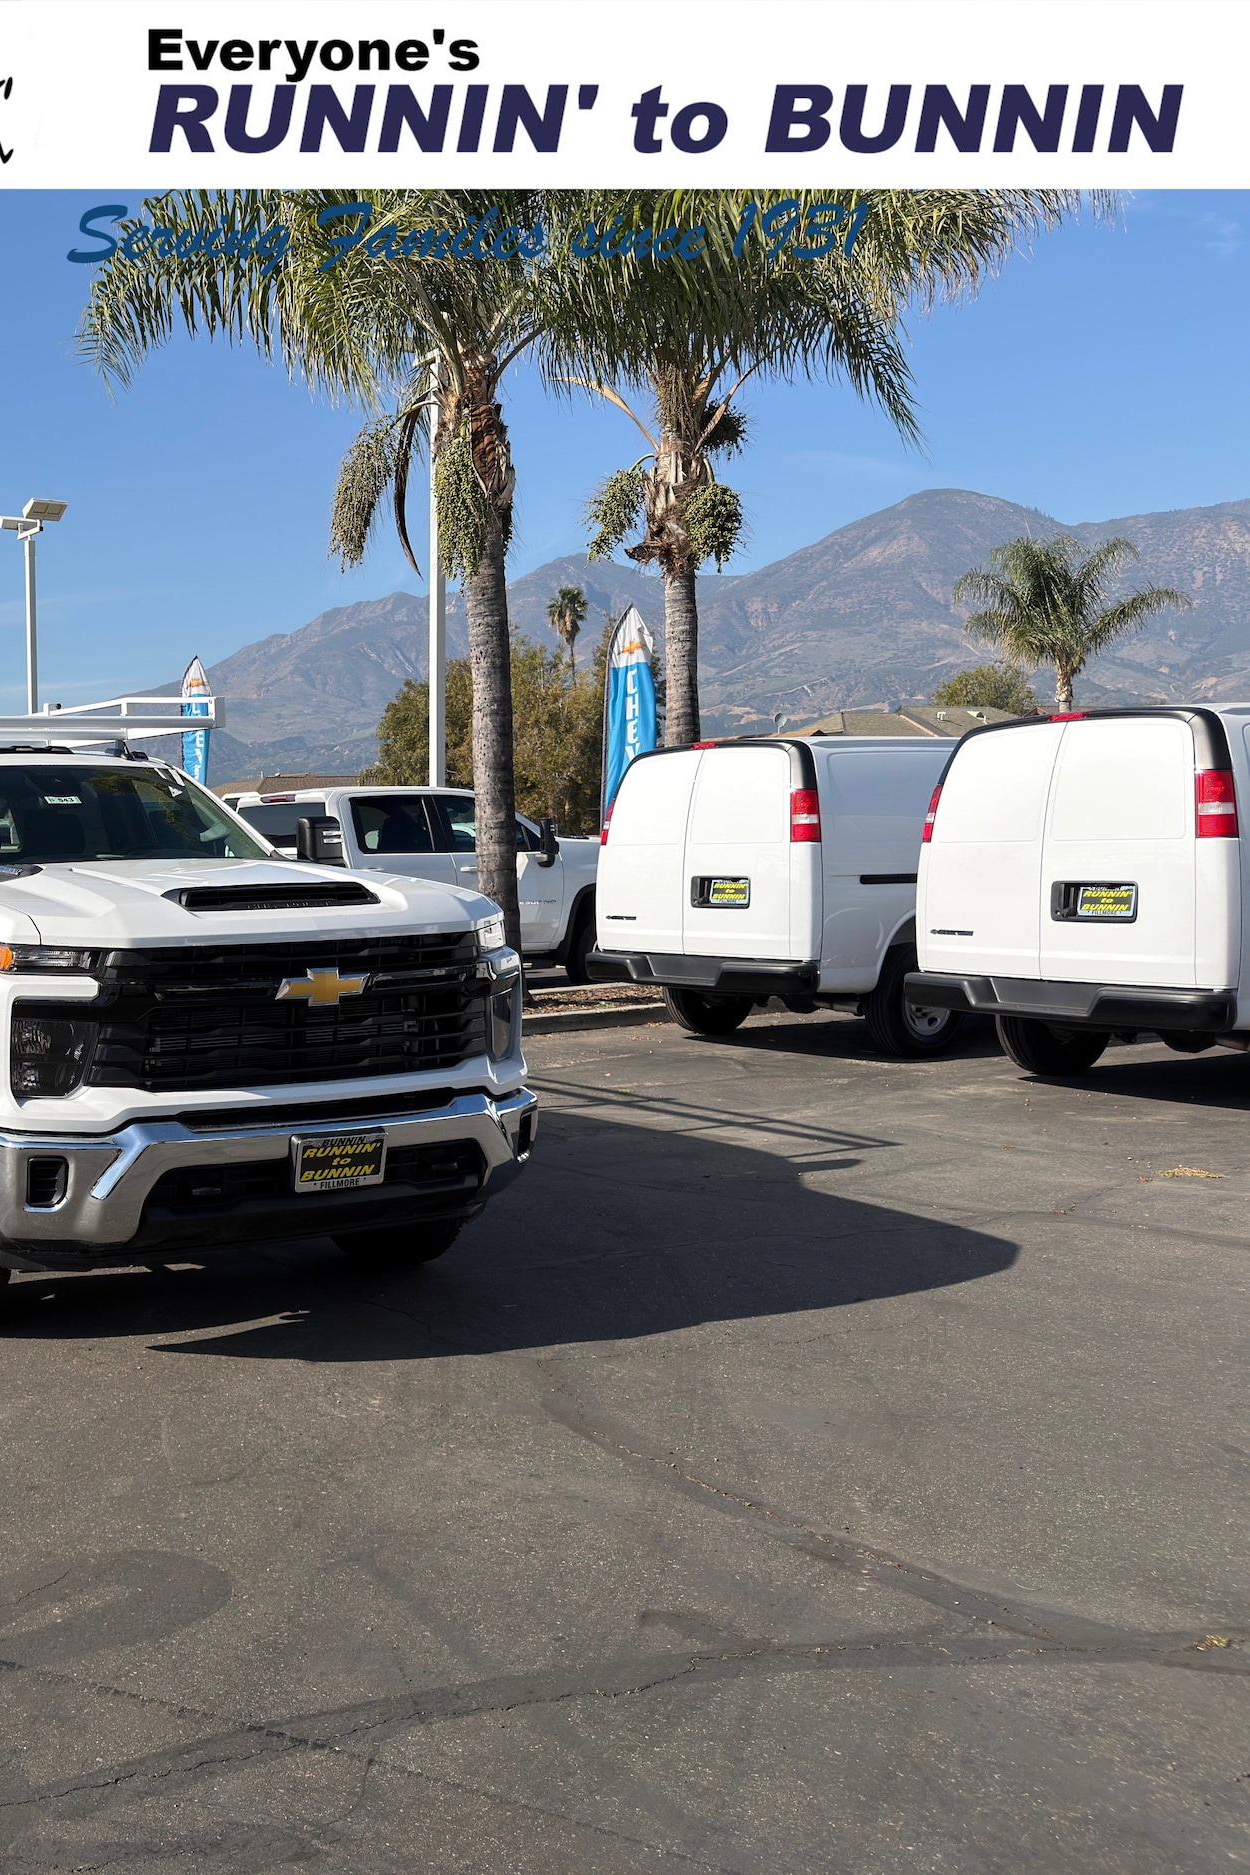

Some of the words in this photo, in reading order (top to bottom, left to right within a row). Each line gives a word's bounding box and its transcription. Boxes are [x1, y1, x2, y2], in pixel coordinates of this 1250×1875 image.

[1083, 890, 1133, 898] RUNNIN'
[1081, 903, 1129, 911] BUNNIN
[322, 1135, 366, 1147] BUNNIN
[303, 1142, 381, 1158] RUNNIN'
[332, 1157, 351, 1166] to
[300, 1164, 375, 1182] BUNNIN
[320, 1178, 360, 1190] FILLMORE
